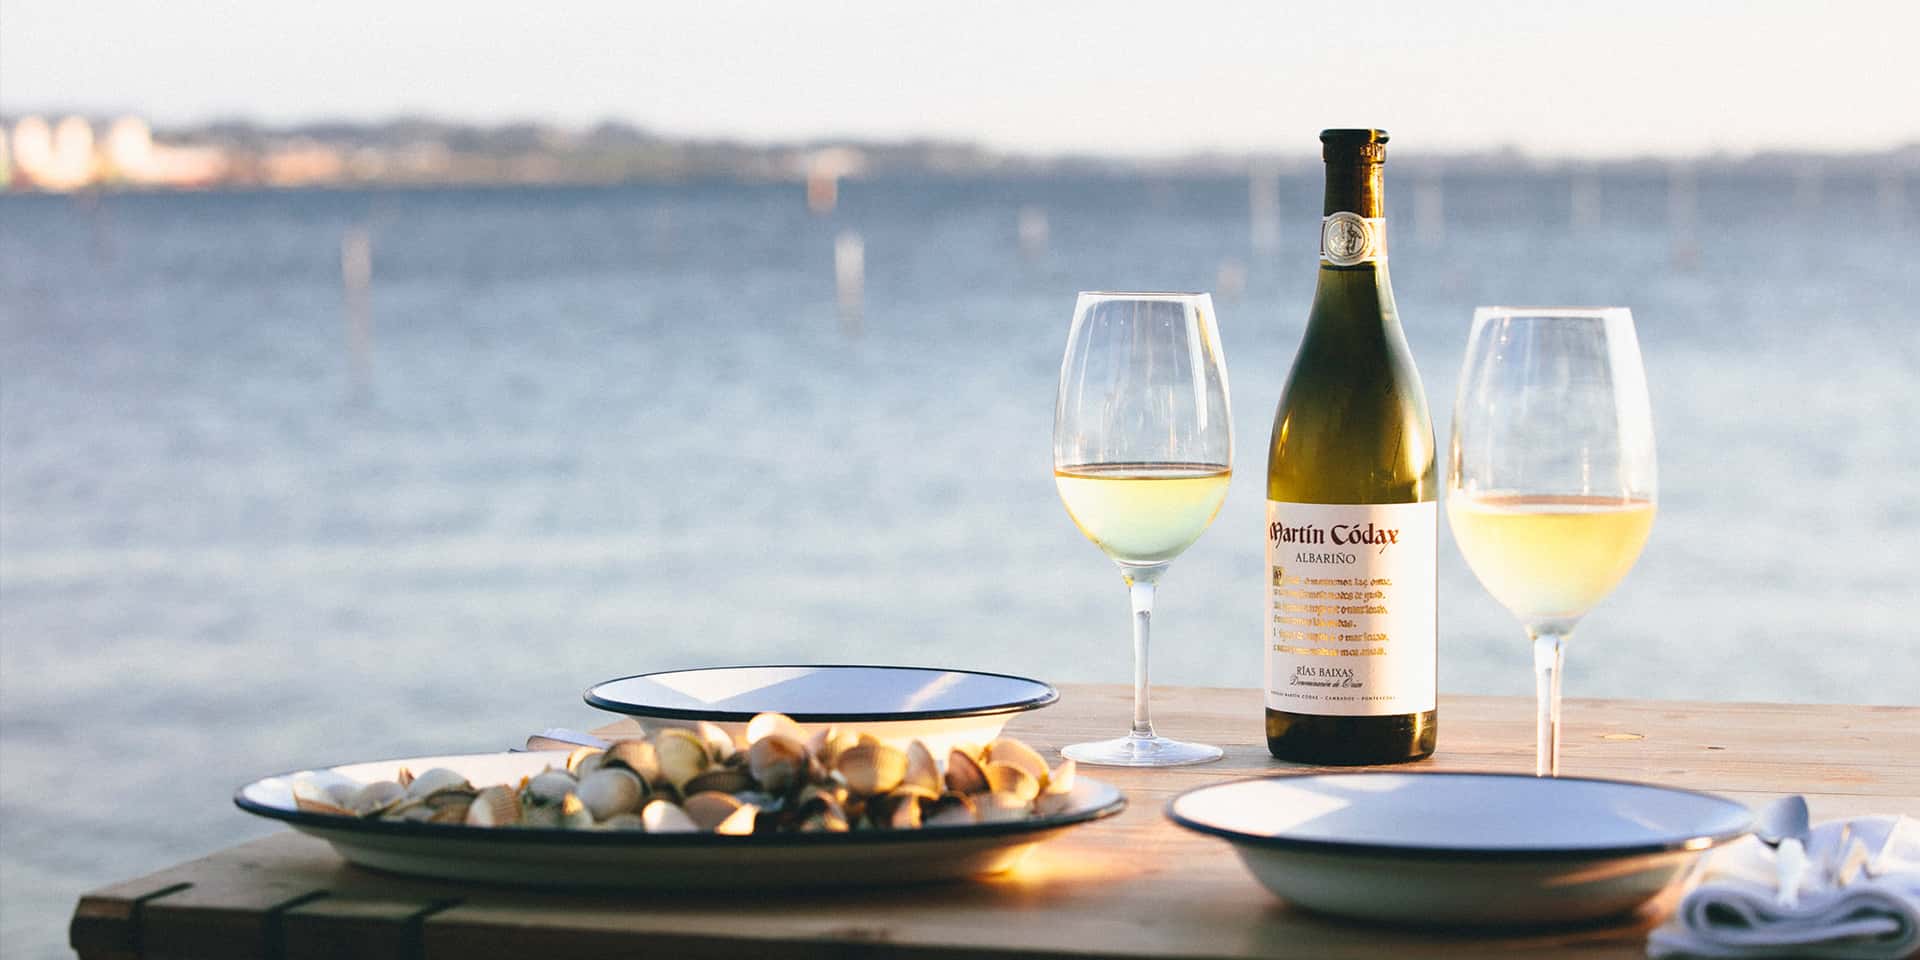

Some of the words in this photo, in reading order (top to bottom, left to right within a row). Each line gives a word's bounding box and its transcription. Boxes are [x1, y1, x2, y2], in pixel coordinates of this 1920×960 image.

[1269, 521, 1325, 549] Martín
[1331, 522, 1399, 554] Códax
[1295, 552, 1357, 565] ALBARIÑO
[1296, 664, 1316, 676] RÍAS
[1319, 667, 1354, 679] BAIXAS
